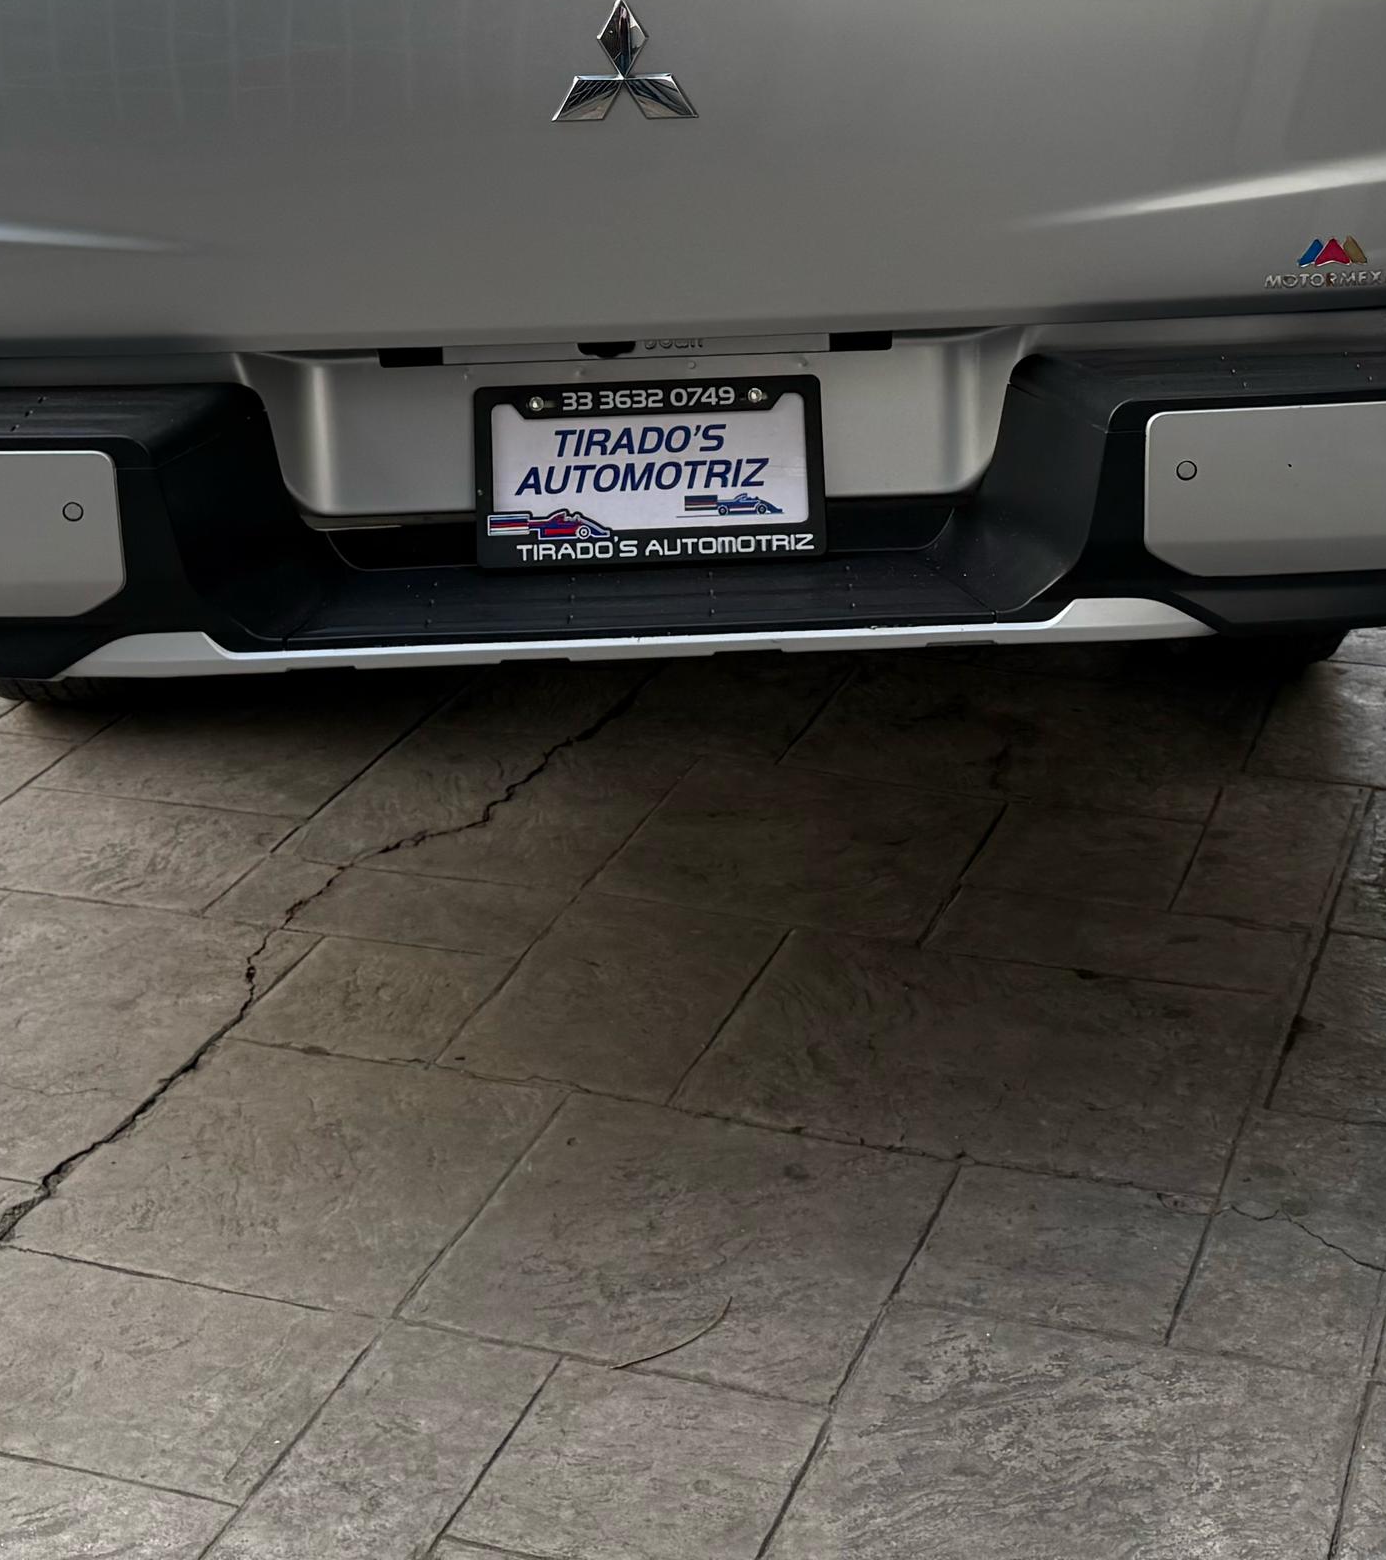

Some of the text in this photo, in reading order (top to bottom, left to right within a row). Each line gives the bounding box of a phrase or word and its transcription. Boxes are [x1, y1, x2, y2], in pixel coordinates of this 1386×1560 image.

[562, 386, 736, 411] 33 3632 0749
[553, 423, 727, 457] TIRADO'S
[515, 457, 769, 496] AUTOMOTRIZ
[516, 532, 815, 561] TIRADO'S AUTOMOTRIZ
